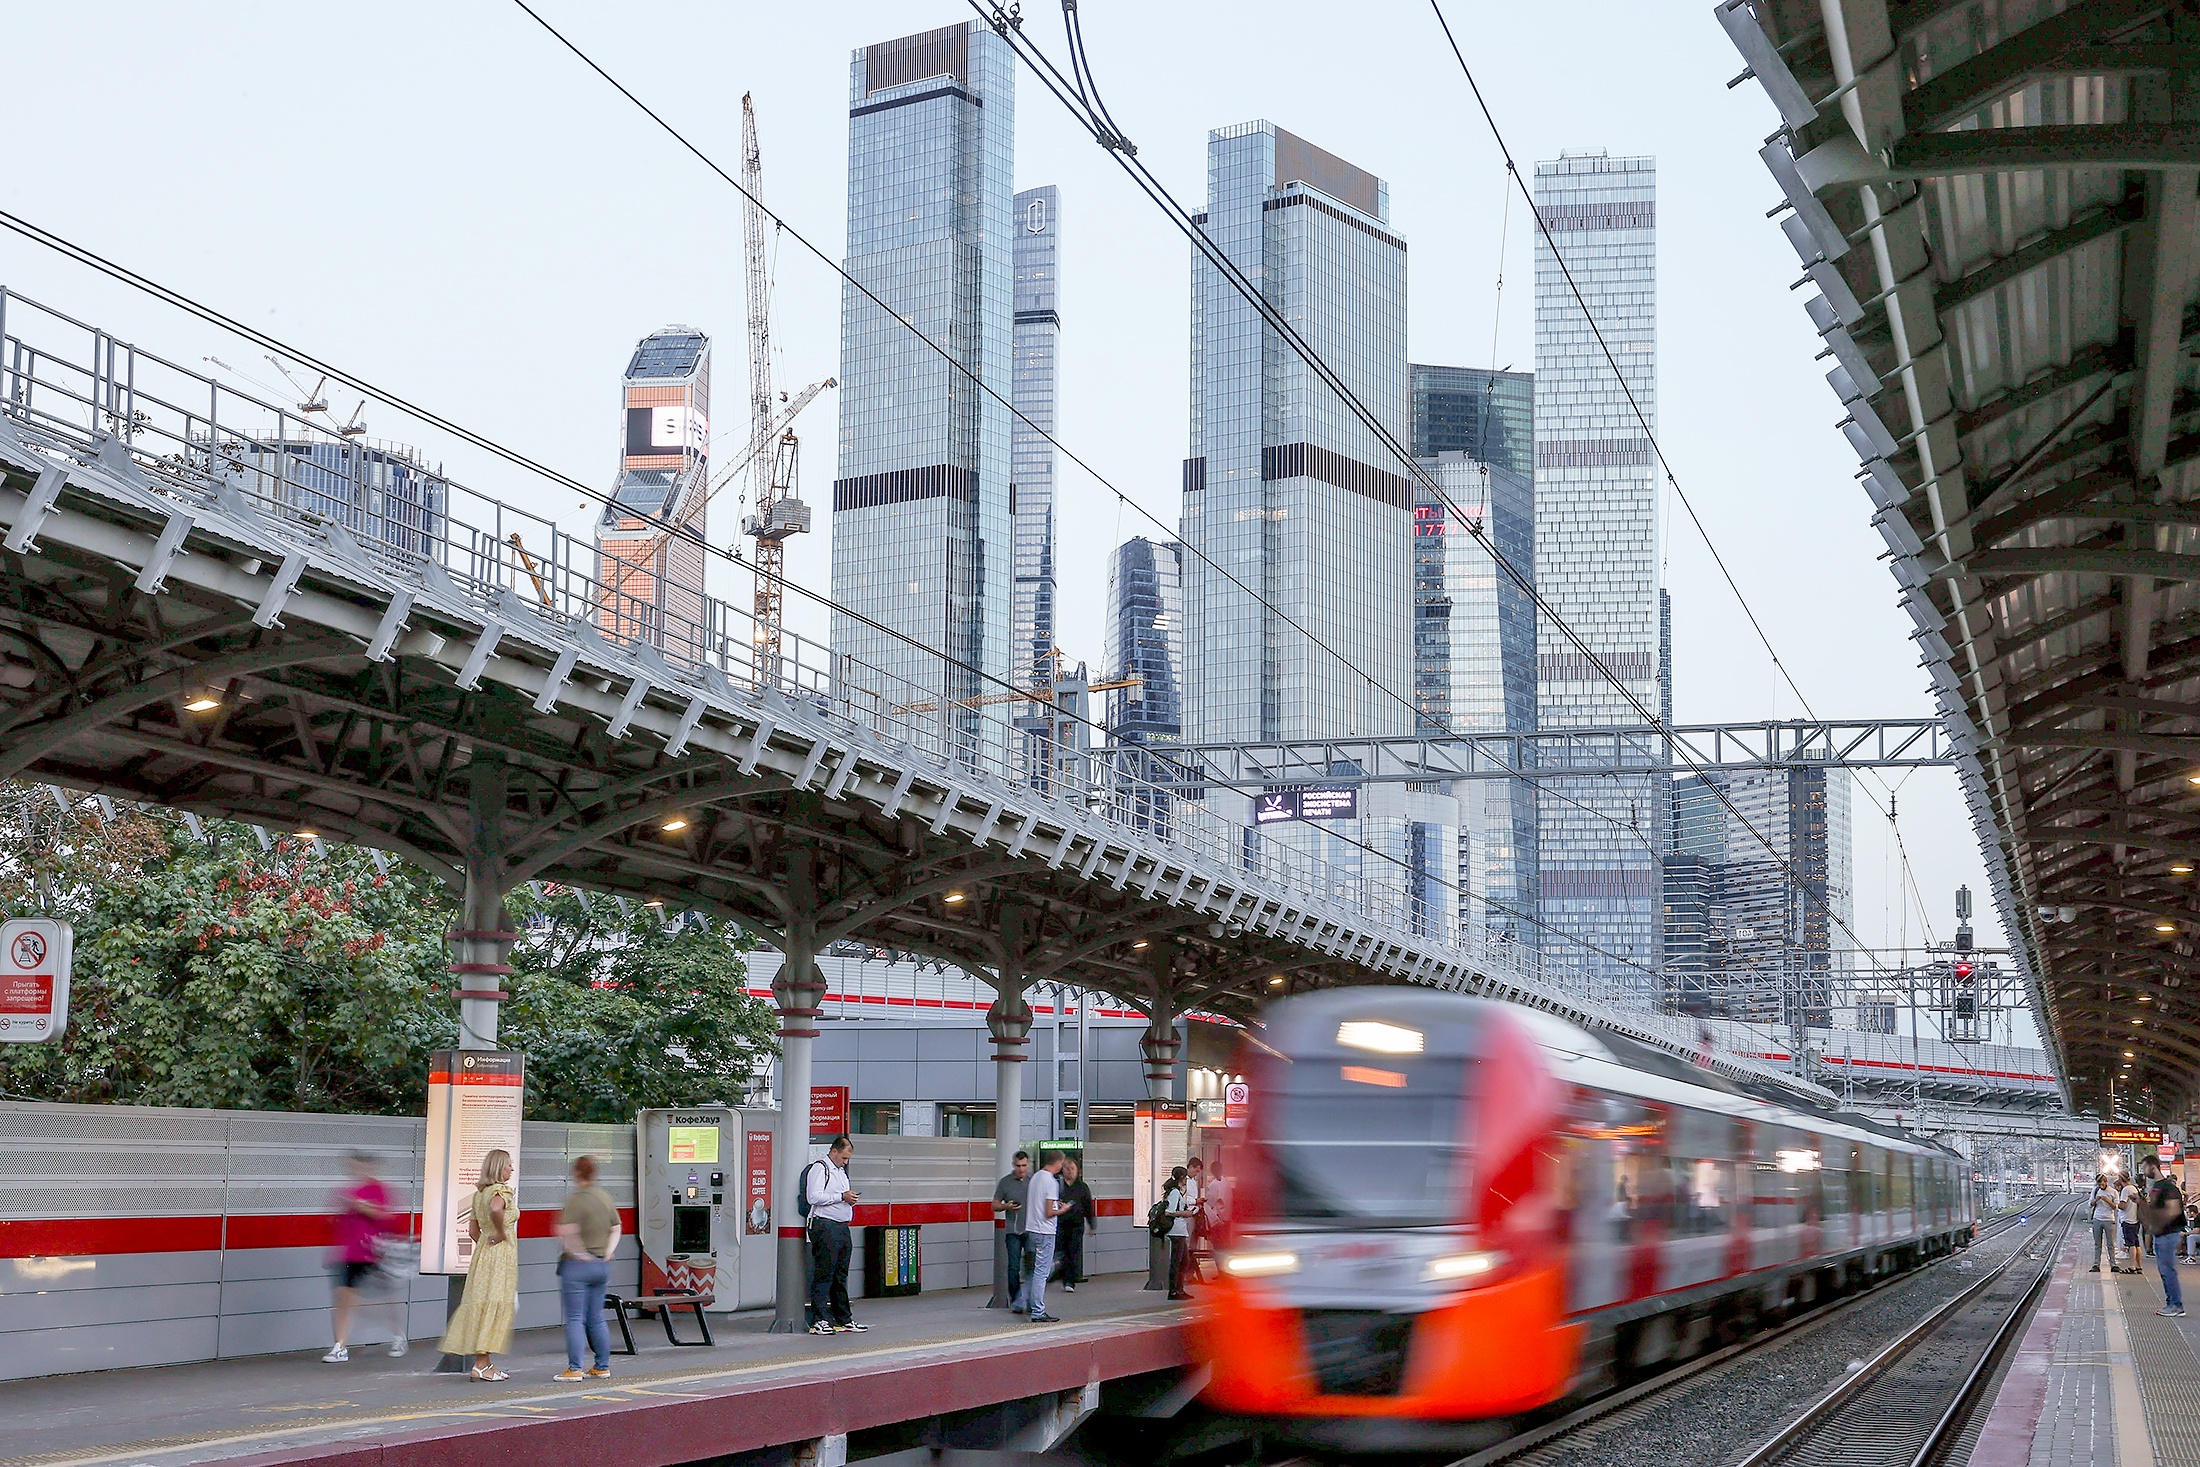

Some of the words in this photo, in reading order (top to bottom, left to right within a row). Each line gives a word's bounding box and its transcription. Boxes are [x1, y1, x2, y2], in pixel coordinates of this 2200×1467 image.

[1302, 791, 1352, 800] РОССИЙСКАЯ
[1302, 800, 1352, 808] ЭКОСИСТЕМА
[1302, 808, 1332, 816] ПЕЧАТИ
[12, 981, 40, 989] Прыгать
[9, 988, 47, 996] платформы
[675, 1116, 720, 1124] КофеХауз
